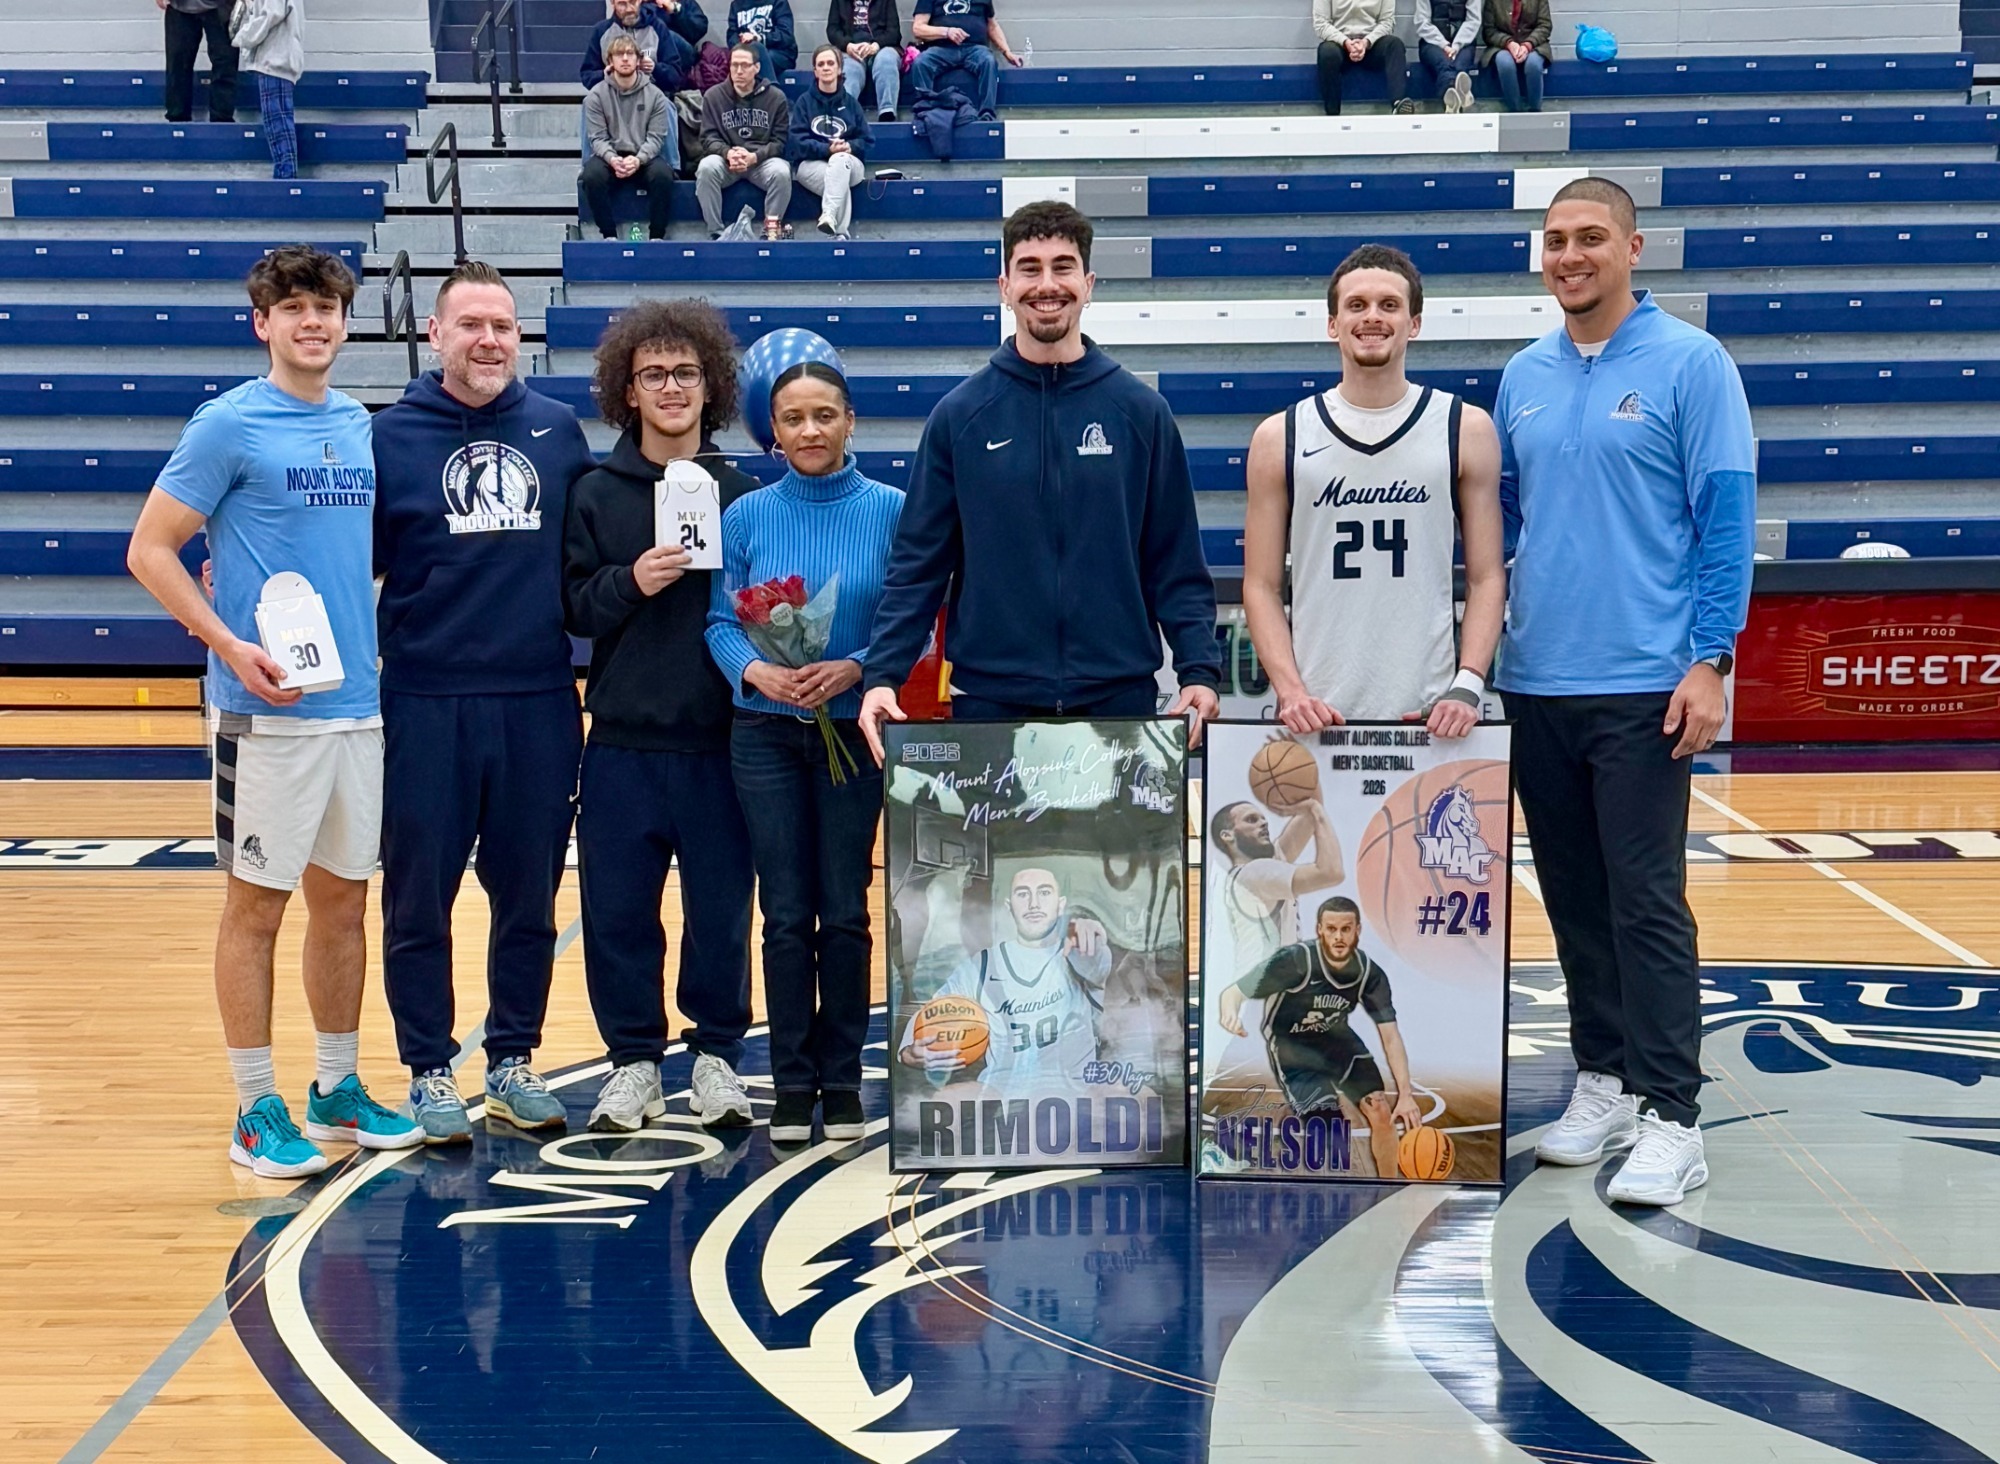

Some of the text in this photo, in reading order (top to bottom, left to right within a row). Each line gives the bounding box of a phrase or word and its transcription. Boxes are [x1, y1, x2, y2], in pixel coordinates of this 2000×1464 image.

[286, 467, 375, 491] MOUNT ALOYSIUS
[1313, 476, 1431, 507] Mounties
[305, 494, 369, 506] BASKETBALL
[448, 512, 540, 532] MOUNTIES
[677, 511, 707, 522] MVP
[680, 523, 707, 551] 24
[1333, 519, 1408, 580] 24
[1872, 628, 1957, 638] FRESH FOOD
[289, 642, 321, 671] 30
[1823, 654, 2000, 687] SHEETZ
[1858, 702, 1964, 713] MADE TO ORDER
[1319, 730, 1431, 746] MOUNT ALOYSIUS COLLEGE
[902, 743, 961, 762] 2026
[1332, 755, 1415, 771] MEN'S BASKETBALL
[928, 738, 1146, 800] Mount Aloysius College
[1128, 785, 1177, 815] MAC
[1363, 779, 1387, 795] 2026
[241, 847, 268, 869] MAC
[1415, 835, 1498, 885] MAC
[1417, 890, 1492, 936] #24
[925, 1003, 976, 1020] Wilson
[994, 988, 1066, 1016] Mounties
[1010, 1014, 1059, 1053] 30
[1083, 1061, 1121, 1083] #30
[919, 1096, 1163, 1158] RIMOLDI
[1217, 1115, 1352, 1172] NELSON
